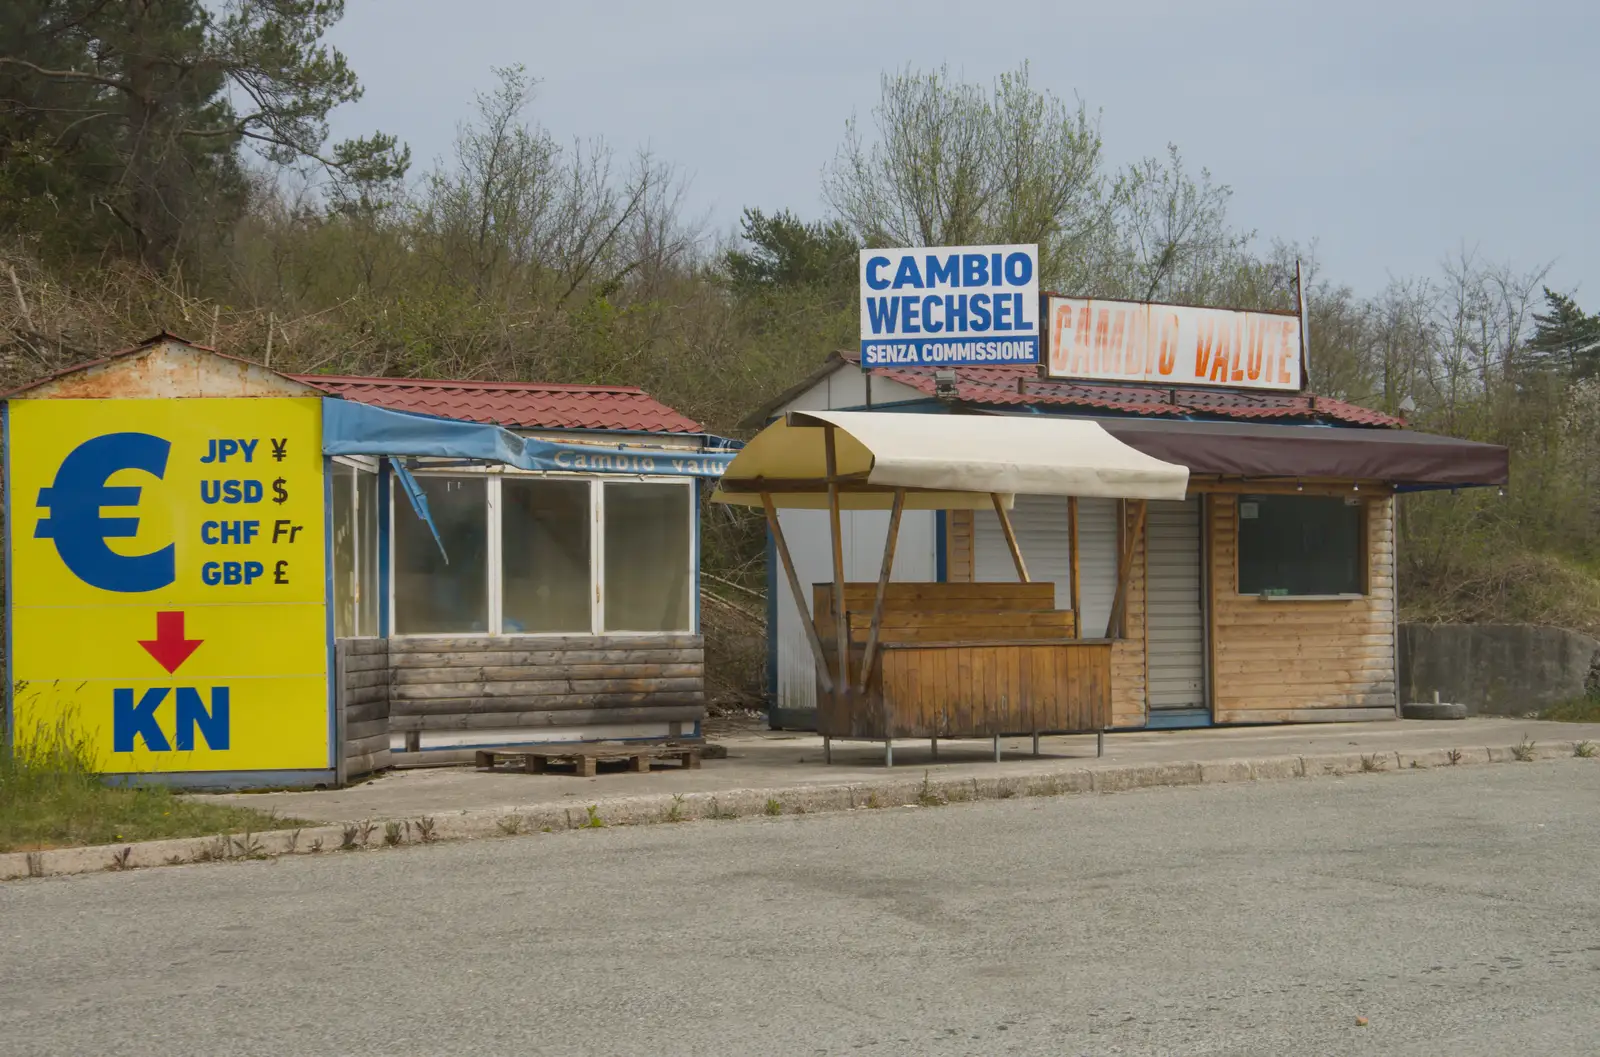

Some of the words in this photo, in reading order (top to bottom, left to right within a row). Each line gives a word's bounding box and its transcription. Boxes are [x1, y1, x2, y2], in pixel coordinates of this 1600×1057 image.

[866, 252, 1033, 291] CAMBIO
[866, 293, 1034, 335] WECHSEL
[866, 344, 919, 364] SENZA
[922, 341, 1034, 362] COMMISSIONE
[1053, 304, 1179, 376] CAMBIO
[1195, 316, 1295, 384] VALUTE
[199, 439, 259, 464] JPY
[672, 459, 731, 475] valu
[200, 480, 264, 504] USD
[272, 477, 289, 505] $
[201, 520, 260, 545] CHF
[272, 519, 303, 544] Fr
[201, 561, 264, 586] GBP
[274, 560, 289, 585] £
[113, 686, 230, 753] KN
